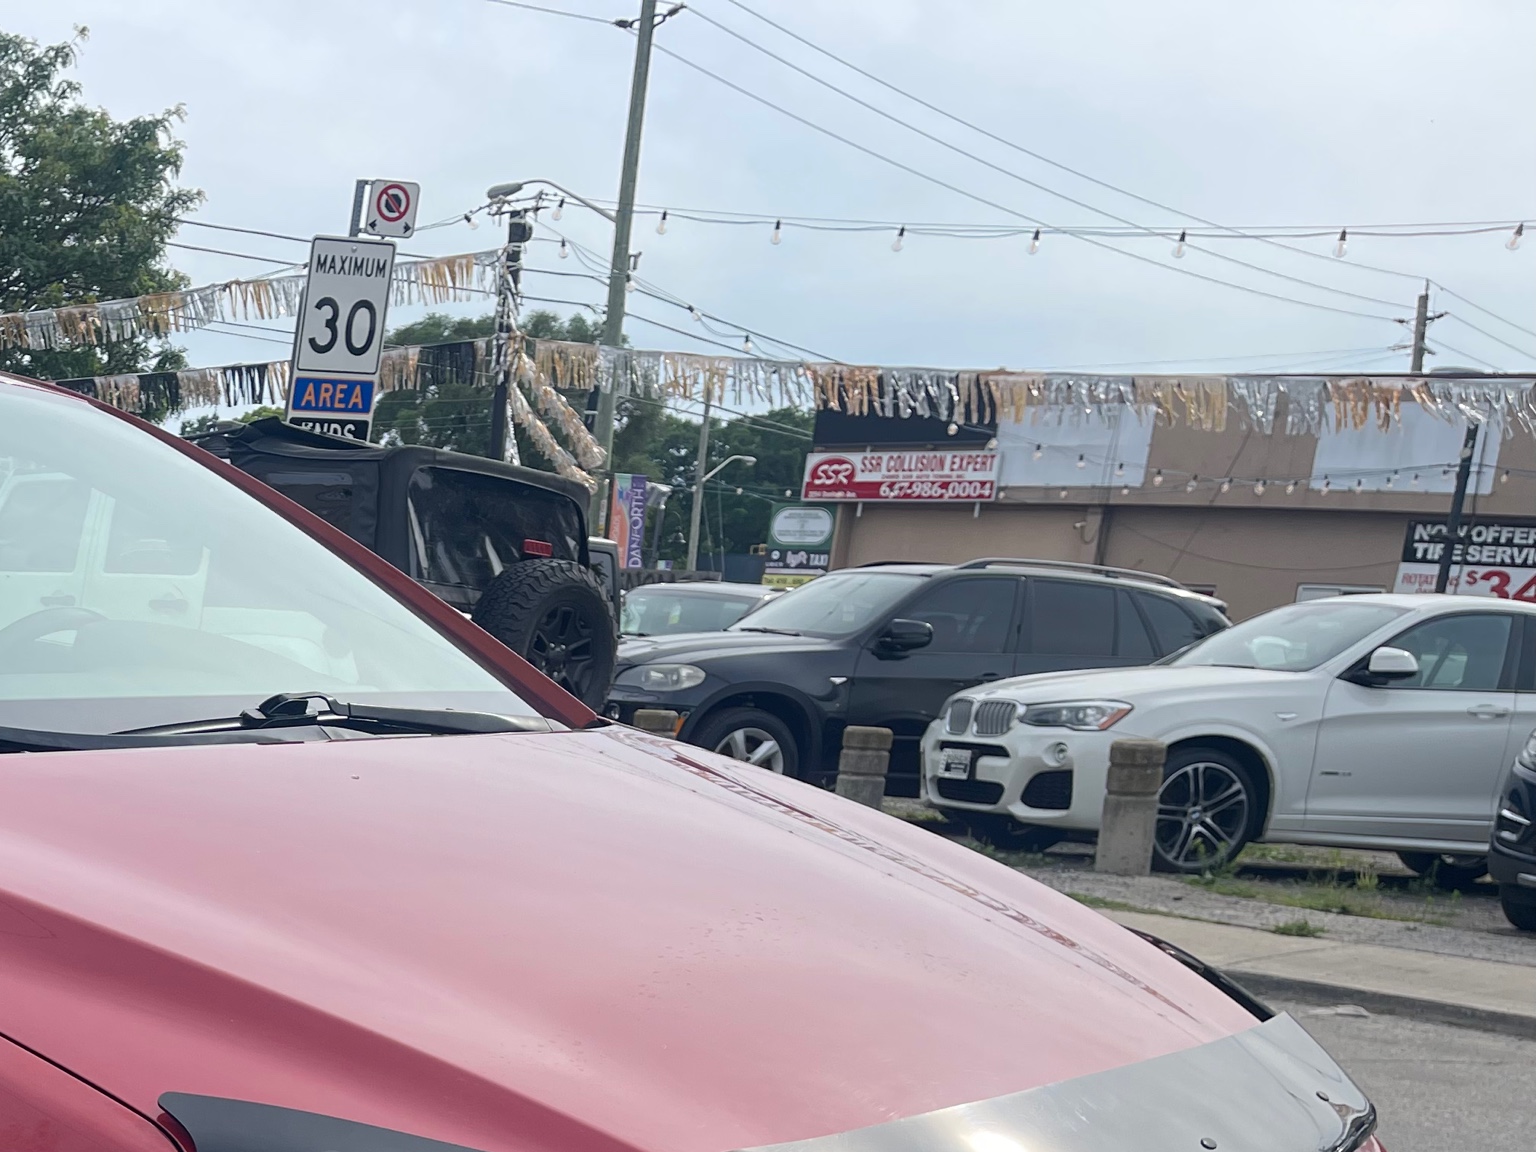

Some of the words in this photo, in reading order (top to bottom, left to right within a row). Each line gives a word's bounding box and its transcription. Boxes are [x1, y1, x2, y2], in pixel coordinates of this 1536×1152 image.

[315, 253, 387, 279] MAXIMUM
[308, 296, 377, 357] 30
[300, 382, 363, 409] AREA
[814, 463, 853, 485] SSR
[860, 454, 883, 473] SSR
[886, 453, 946, 473] COLLISION
[949, 453, 996, 473] EXPERT
[628, 489, 644, 568] DANFORTH
[1466, 545, 1536, 566] SERVI
